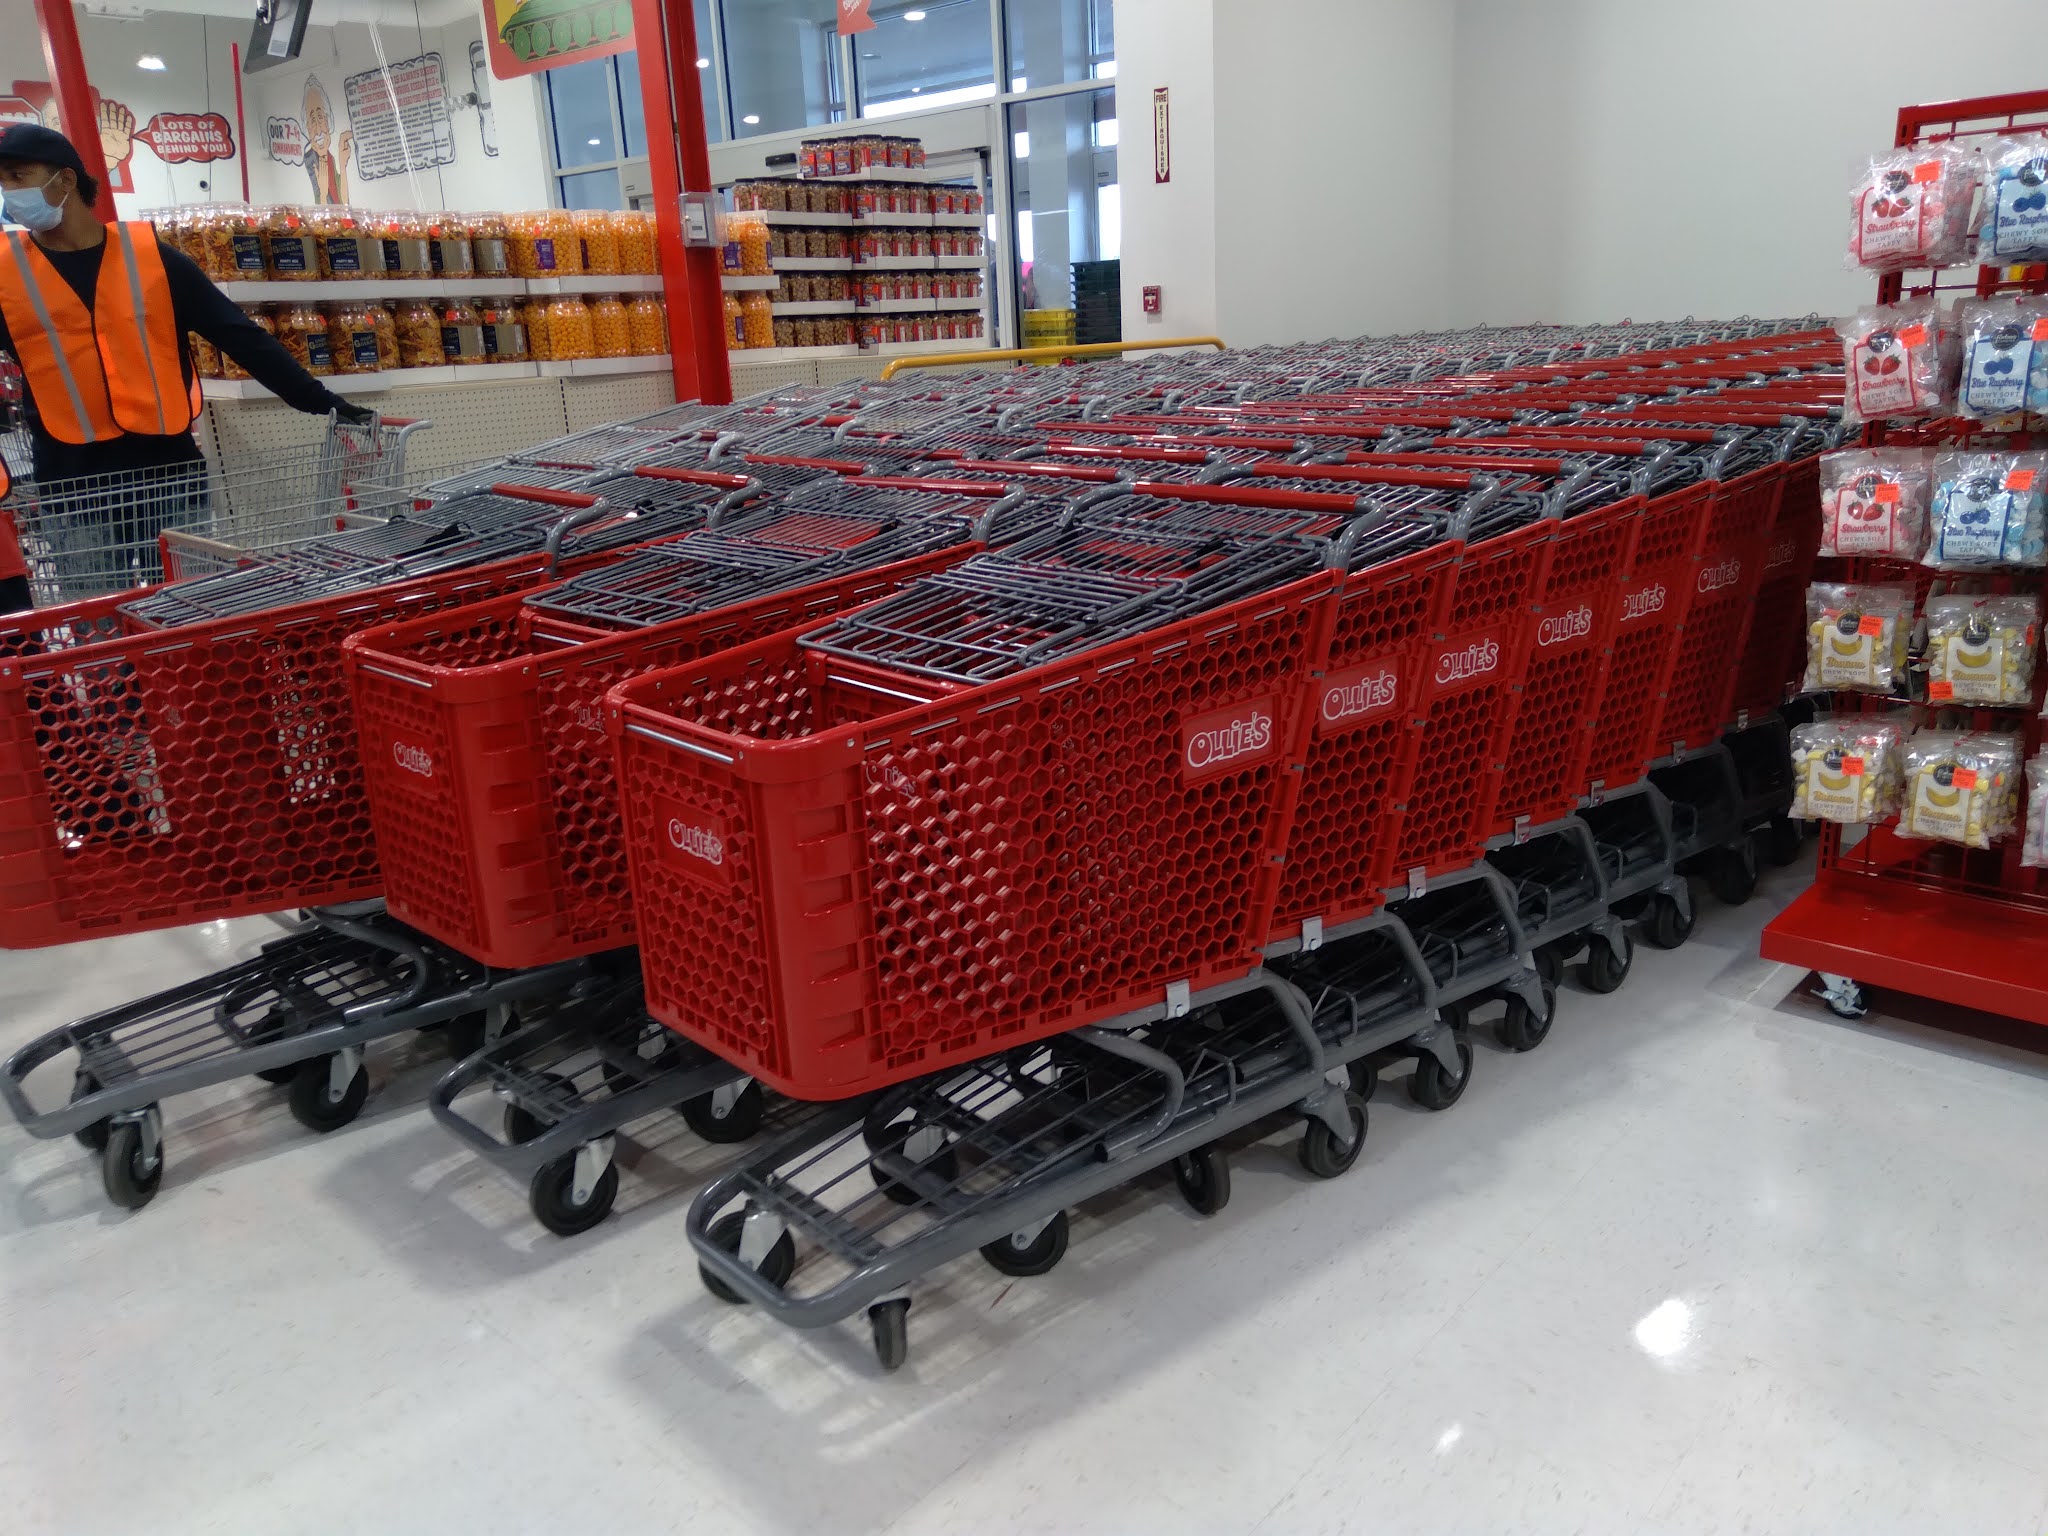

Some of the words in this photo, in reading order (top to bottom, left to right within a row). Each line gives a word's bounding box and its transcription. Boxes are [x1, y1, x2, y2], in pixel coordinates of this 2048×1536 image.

[1155, 94, 1167, 103] FIRE
[160, 121, 193, 130] LOTS
[198, 120, 215, 129] OF
[152, 130, 223, 143] BARGAINS
[270, 124, 284, 139] OUR
[157, 144, 199, 154] BEHIND
[202, 143, 227, 153] YOU!
[1865, 219, 1916, 234] Strawberry
[1999, 216, 2017, 227] Blue
[1865, 234, 1892, 245] CHEWY
[1999, 230, 2029, 239] CHEWY
[1862, 377, 1907, 391] Strawberry
[1971, 377, 1987, 388] Blue
[1989, 376, 2024, 390] Raspberry
[1861, 391, 1886, 401] CHEWY
[1840, 523, 1888, 536] Strawberry
[1947, 526, 1964, 537] Blue
[1965, 526, 2001, 541] Raspberry
